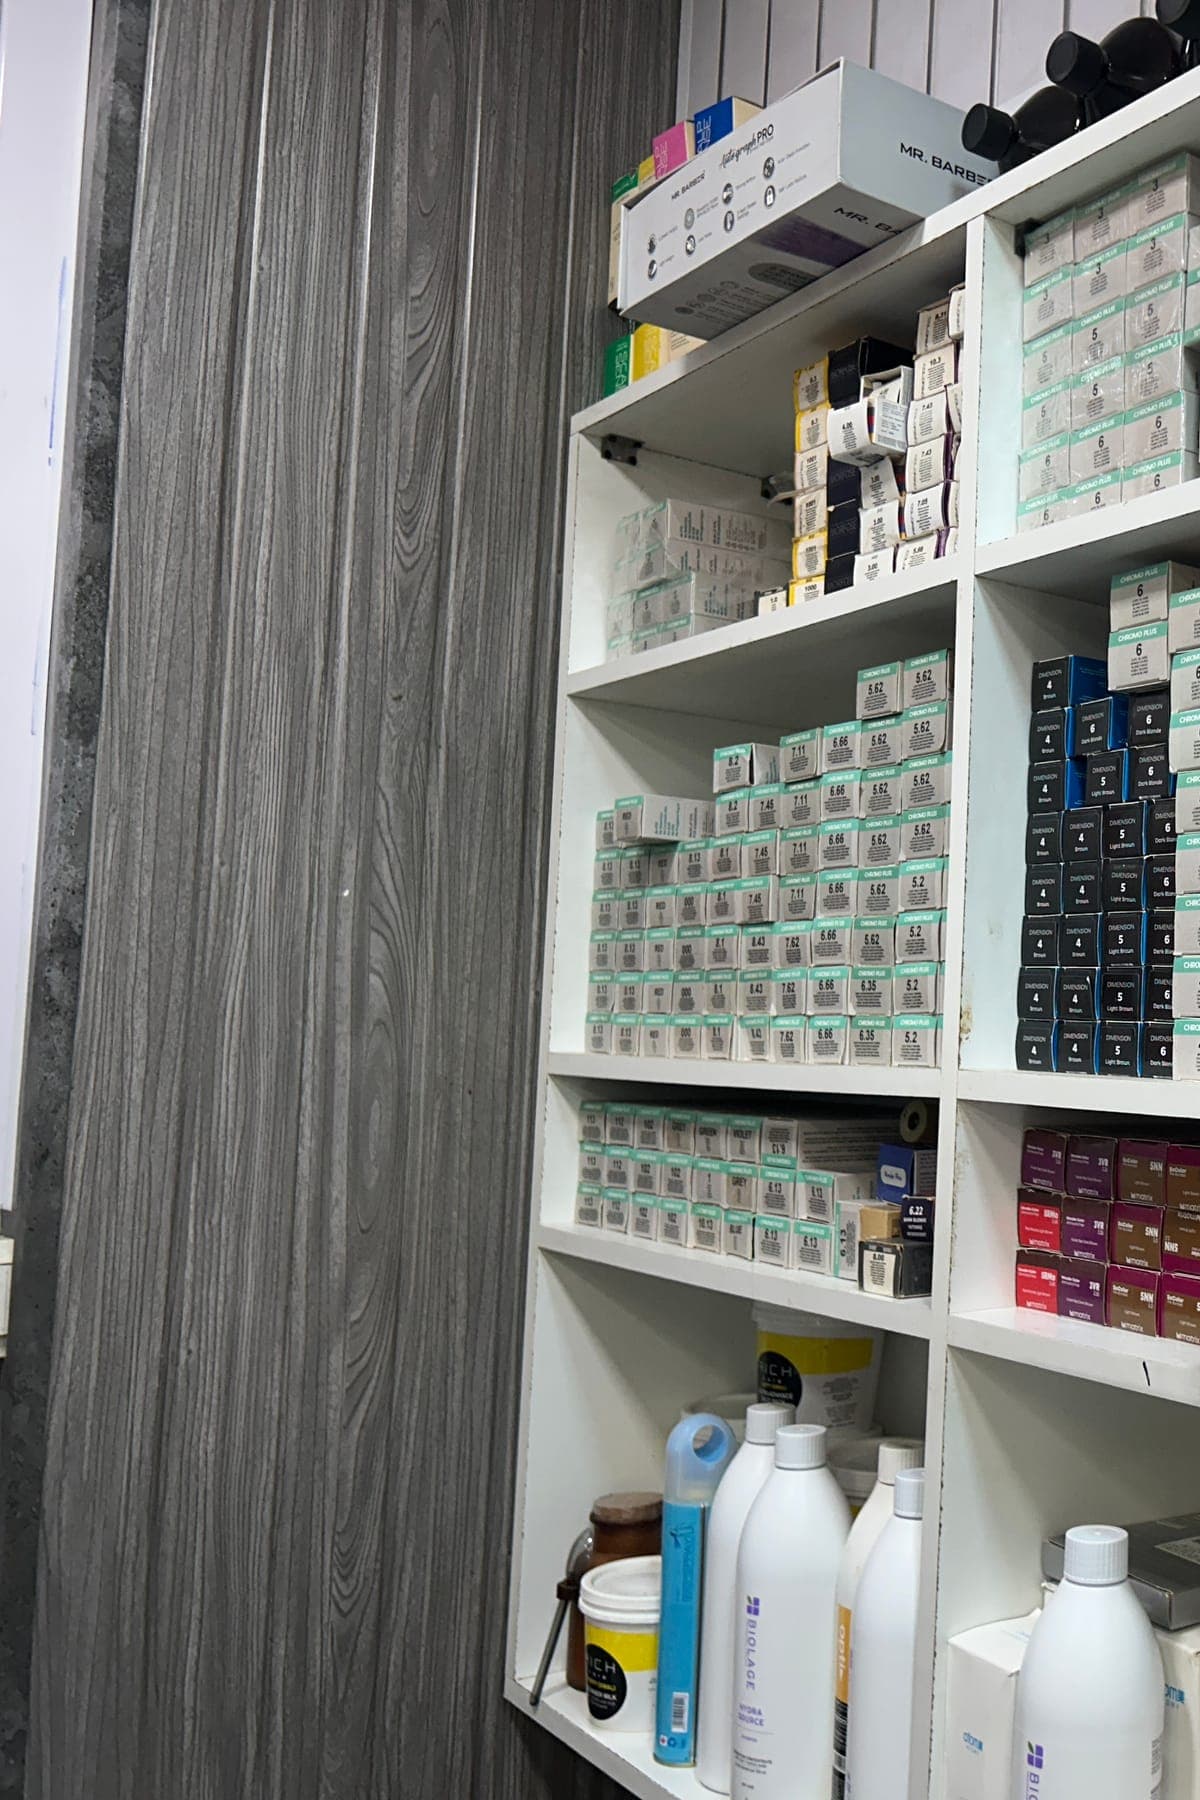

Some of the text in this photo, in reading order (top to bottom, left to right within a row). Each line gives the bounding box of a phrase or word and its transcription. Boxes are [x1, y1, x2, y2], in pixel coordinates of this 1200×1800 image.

[900, 143, 927, 163] MR.
[1093, 328, 1097, 340] 5
[1133, 398, 1172, 418] CHROMO PLUS
[1156, 416, 1161, 428] 6
[1098, 436, 1104, 448] 6
[1179, 592, 1200, 603] CHROMO
[1136, 643, 1142, 656] 6
[911, 654, 939, 666] CHROMO PLUS
[916, 670, 932, 683] 5.62
[868, 682, 883, 695] 5.62
[1146, 715, 1152, 724] 6
[833, 736, 848, 747] 6.66
[792, 745, 805, 755] 7.11
[913, 773, 930, 786] 5.62
[1079, 833, 1084, 841] 4
[1120, 830, 1125, 838] 5
[912, 876, 925, 888] 5.2
[782, 983, 795, 993] 7.62
[861, 981, 876, 991] 6.35
[1033, 993, 1039, 1002] 4
[1118, 993, 1123, 1001] 5
[818, 1029, 833, 1039] 6.66
[905, 1032, 917, 1043] 5.2
[1161, 1047, 1166, 1055] 6
[909, 1206, 923, 1215] 6.22
[1145, 1227, 1158, 1237] 5NN
[804, 1237, 817, 1248] 6.13
[745, 1619, 757, 1690] BIOLAGE
